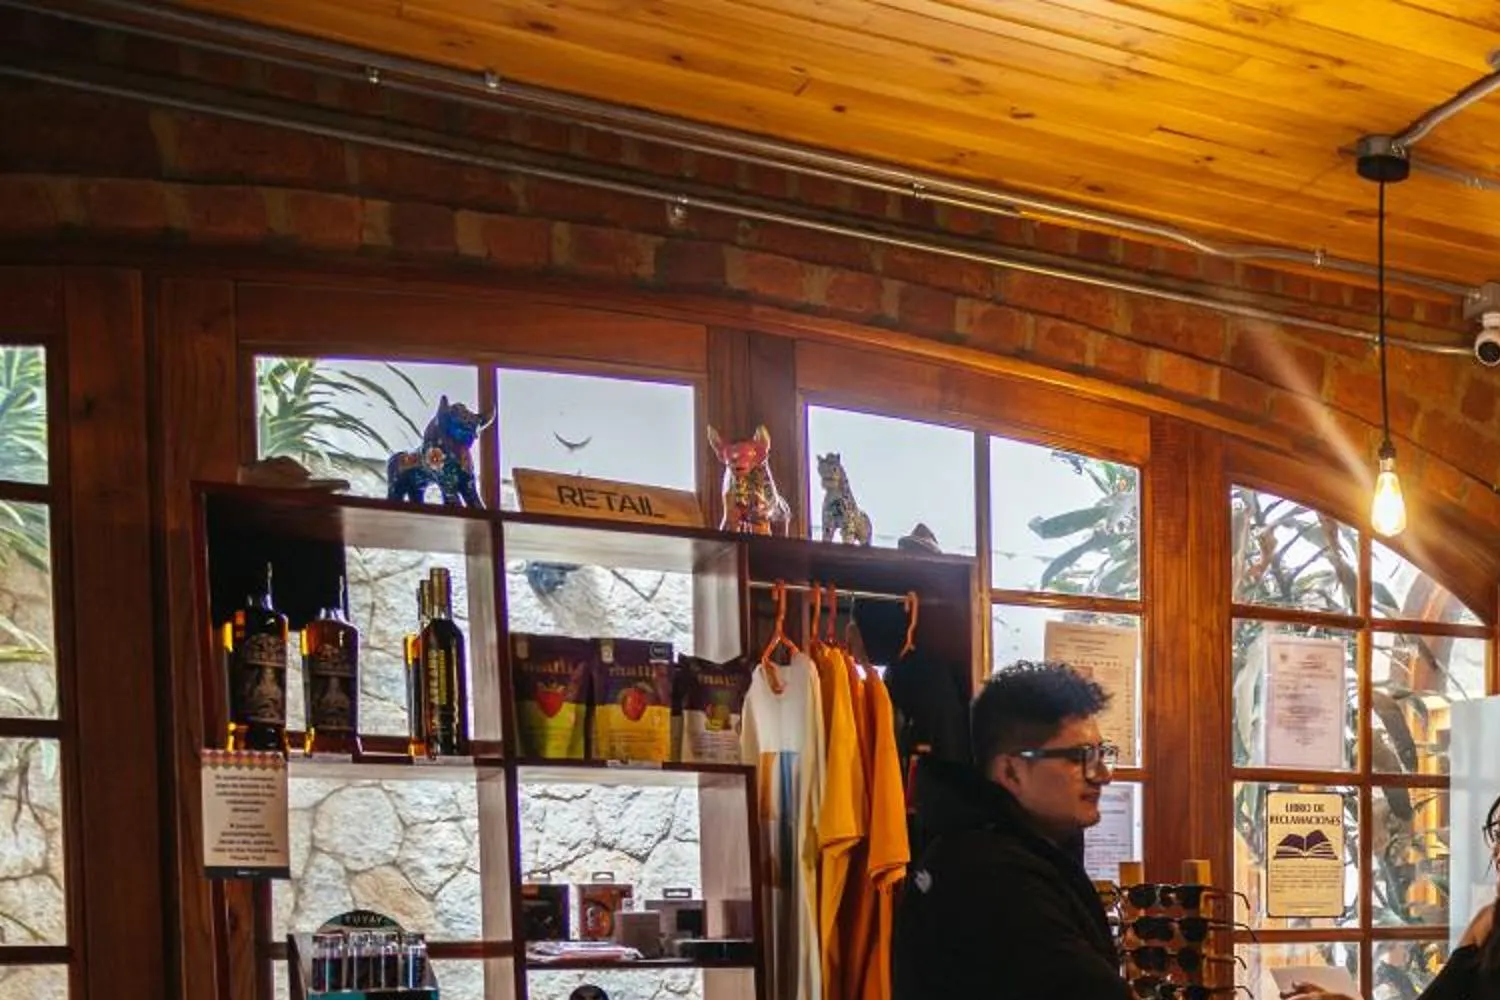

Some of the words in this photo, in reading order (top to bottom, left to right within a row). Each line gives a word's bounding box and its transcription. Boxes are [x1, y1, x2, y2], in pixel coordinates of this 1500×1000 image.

[557, 486, 666, 518] RETAIL
[1285, 803, 1311, 813] LIBRO
[1313, 803, 1325, 813] DE
